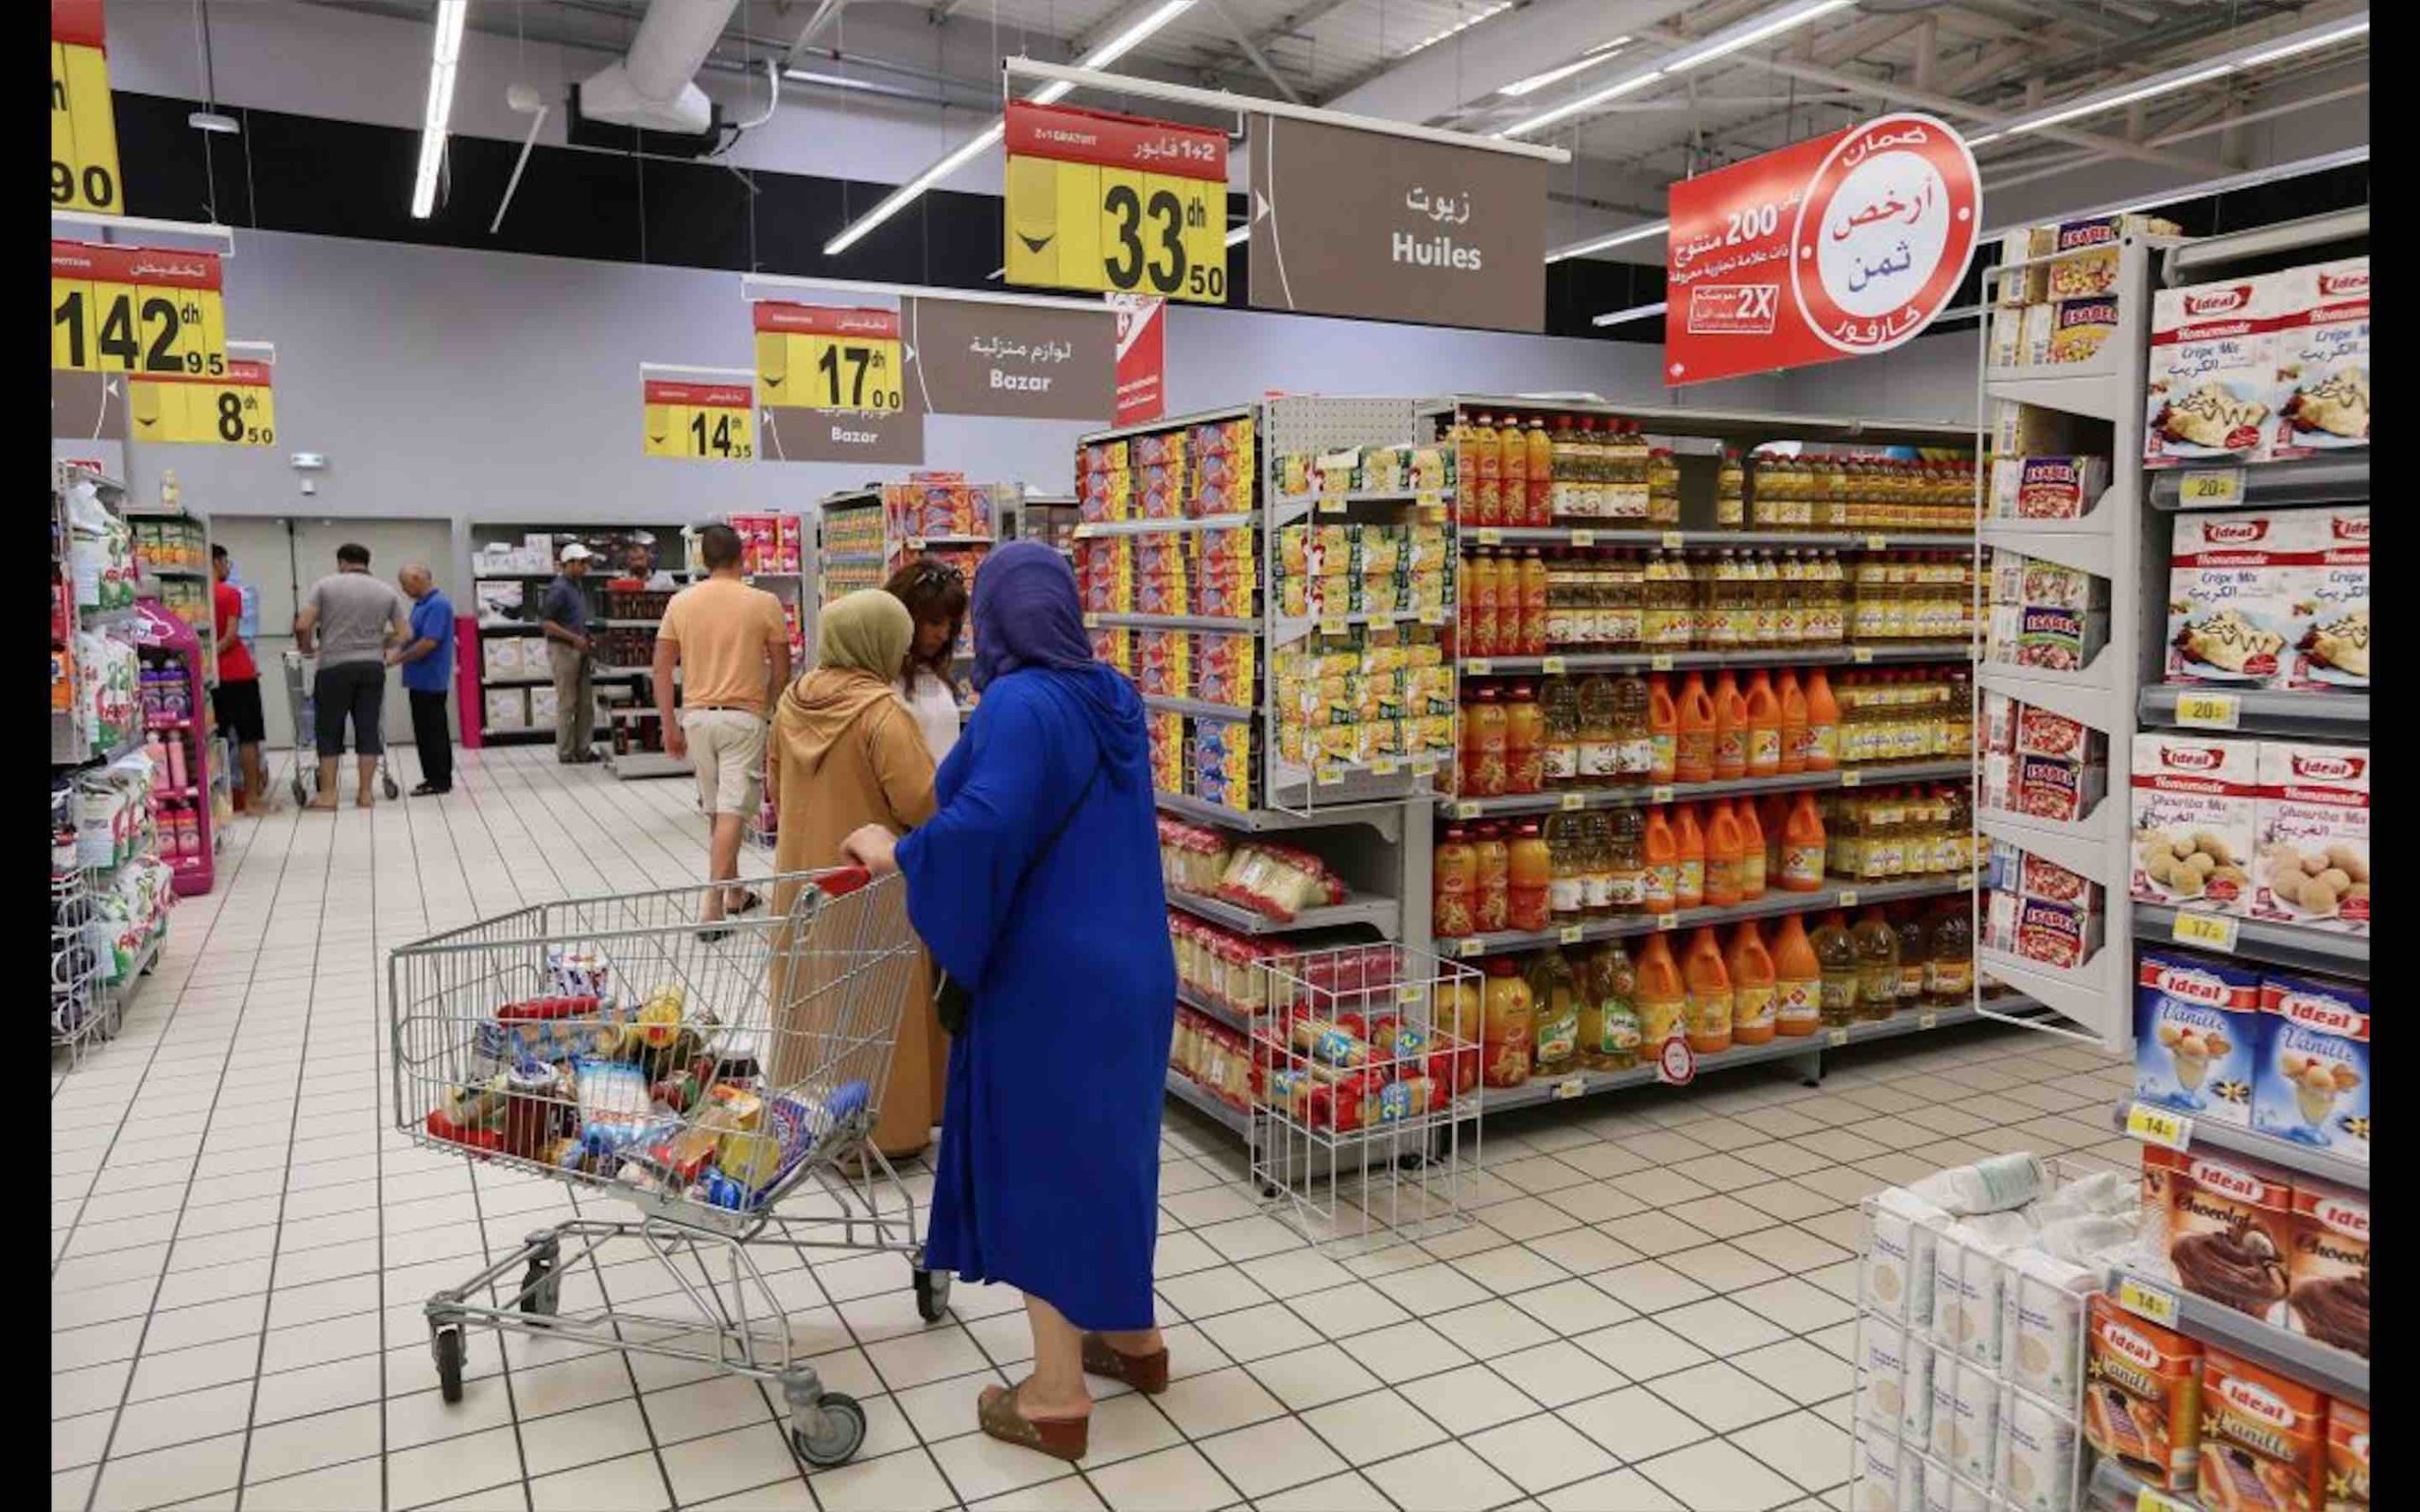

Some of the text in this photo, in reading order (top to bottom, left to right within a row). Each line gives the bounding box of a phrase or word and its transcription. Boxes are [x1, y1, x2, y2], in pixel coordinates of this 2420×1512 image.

[1842, 126, 1928, 166] ضمان
[51, 161, 112, 207] 90
[1187, 197, 1206, 228] dh
[1406, 187, 1470, 225] زيوت
[1832, 176, 1933, 240] أرخص
[1104, 185, 1186, 294] 33
[1726, 203, 1777, 246] 200
[1392, 232, 1481, 271] Huiles
[1848, 241, 1911, 292] ثمن
[1190, 265, 1223, 297] 50
[181, 302, 200, 325] dh
[1736, 288, 1772, 318] 2X
[2196, 295, 2235, 310] Ideal
[55, 291, 182, 372] 142
[1834, 305, 1922, 344] كارفور
[187, 352, 223, 375] 95
[969, 336, 1071, 363] لوازم منزلية
[820, 344, 869, 405] 17
[990, 369, 1052, 391] Bazar
[873, 390, 900, 409] 00
[218, 392, 244, 441] 8
[248, 428, 273, 444] 50
[692, 412, 731, 457] 14
[831, 426, 879, 443] Bazar
[2305, 761, 2347, 775] Ideal
[2169, 977, 2221, 1001] Ideal
[2292, 1003, 2352, 1028] Ideal
[2201, 1167, 2254, 1196] Ideal
[2328, 1207, 2369, 1229] Ide
[2109, 1329, 2152, 1363] Ideal
[2228, 1383, 2285, 1419] Ideal
